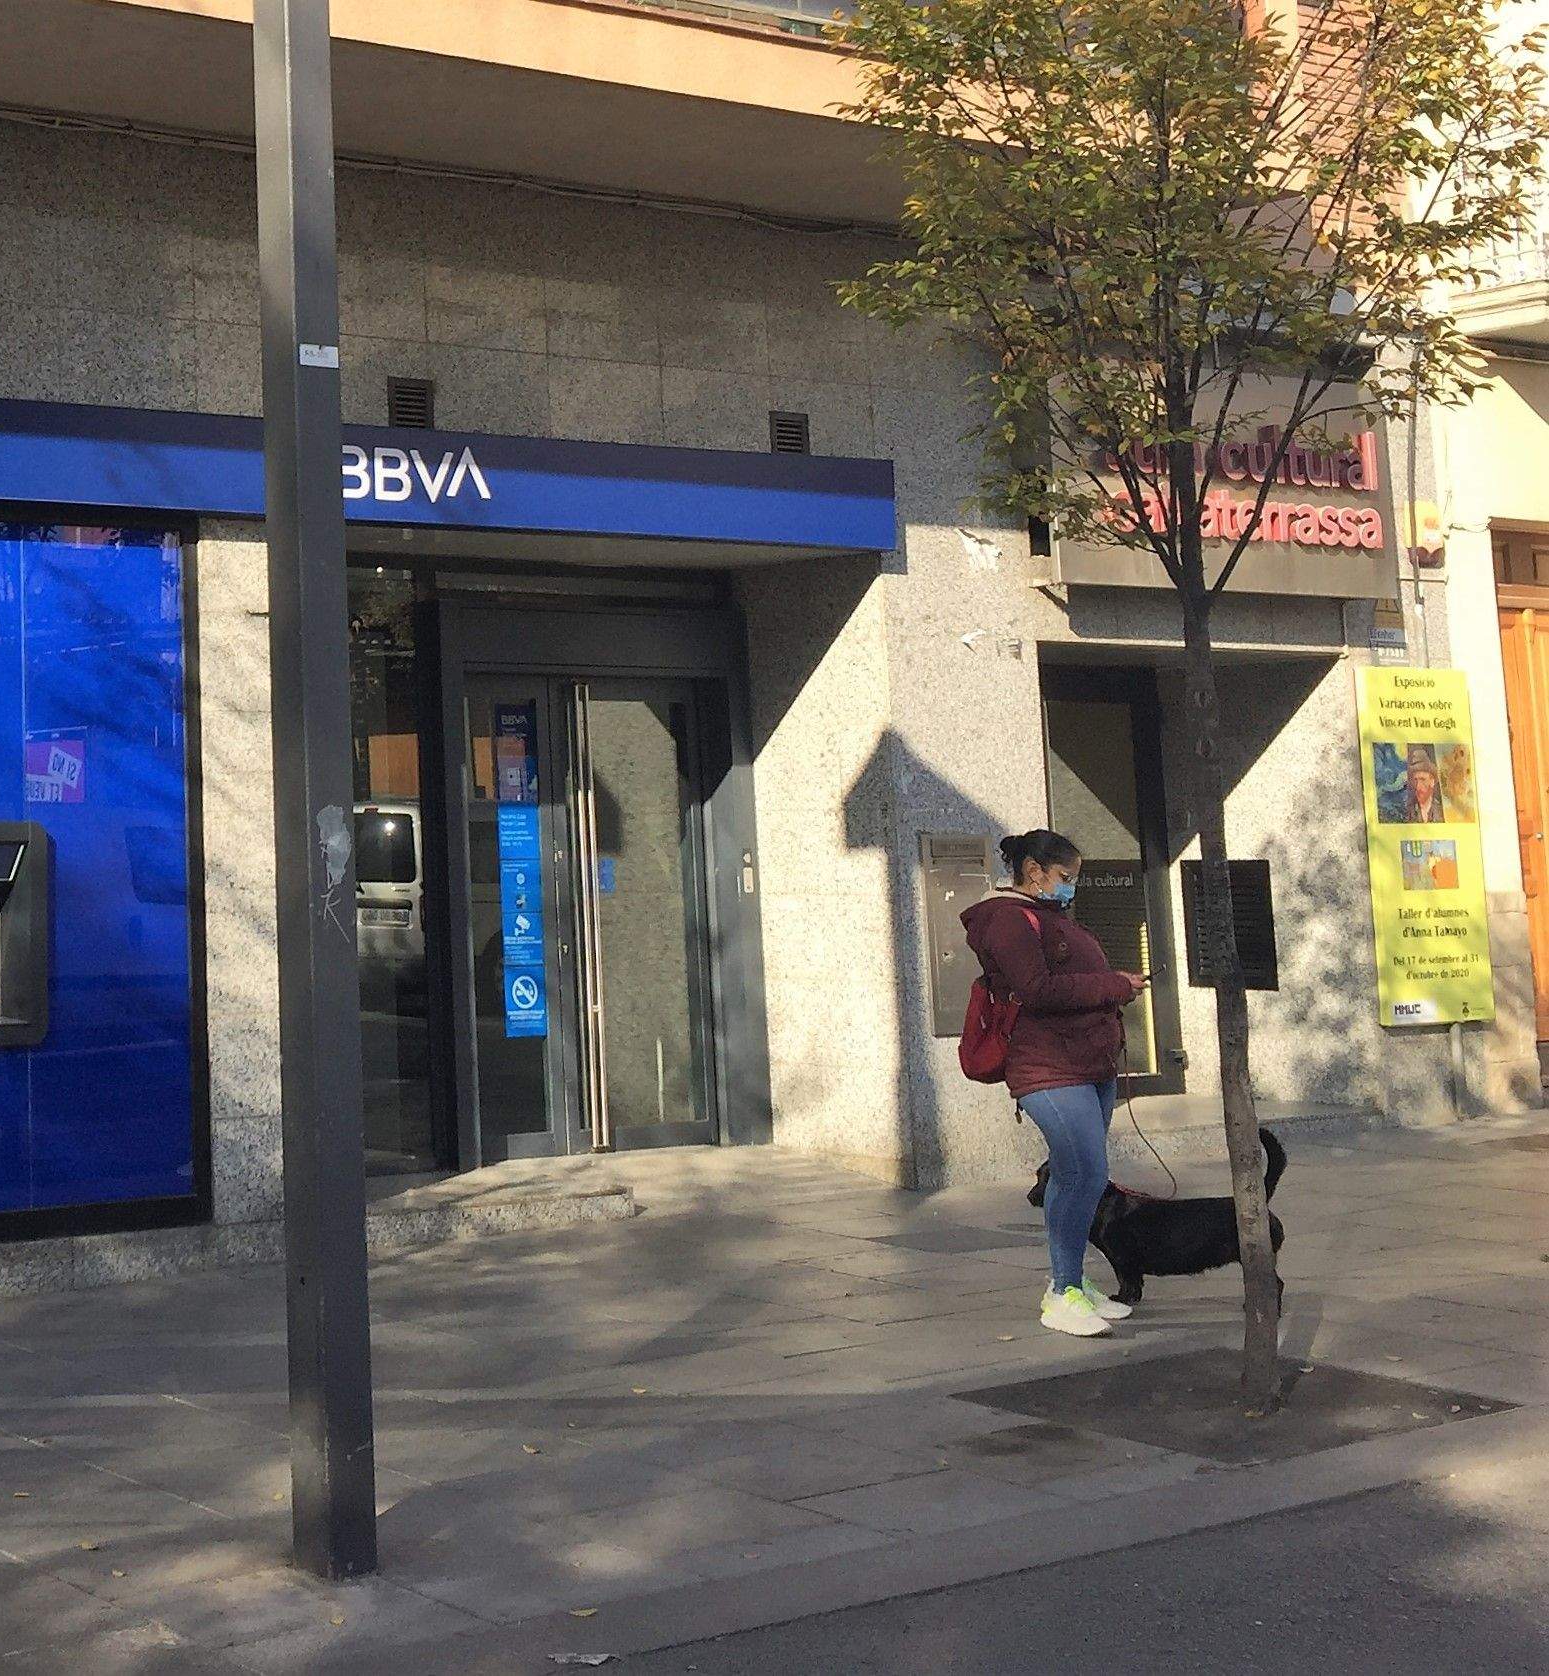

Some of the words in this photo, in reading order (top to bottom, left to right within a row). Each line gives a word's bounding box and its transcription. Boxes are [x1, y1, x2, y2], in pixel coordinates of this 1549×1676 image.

[342, 444, 492, 504] BBVA
[1413, 716, 1431, 728] Van
[1094, 872, 1134, 887] cultural
